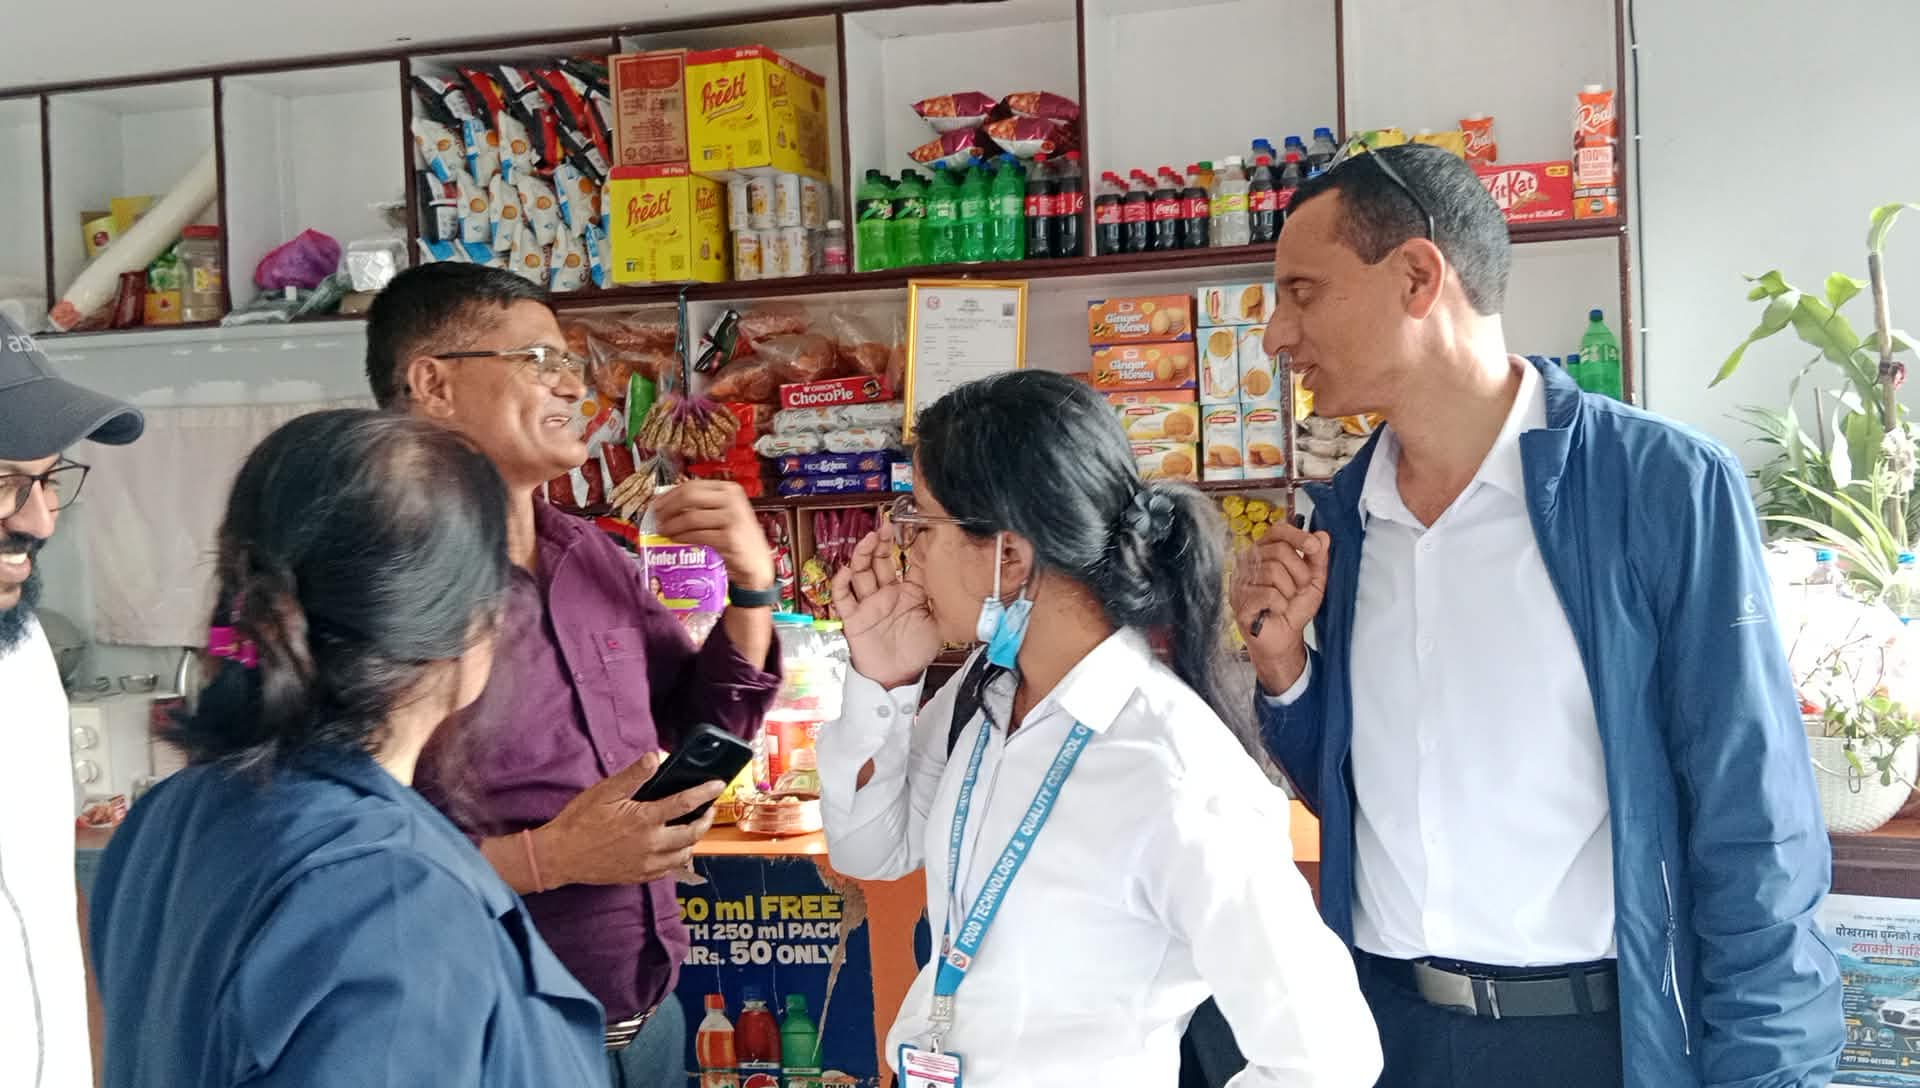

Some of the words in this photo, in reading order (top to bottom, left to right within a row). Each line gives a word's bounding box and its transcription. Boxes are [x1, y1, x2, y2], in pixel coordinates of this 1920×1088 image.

[1114, 322, 1150, 335] Honey
[1110, 360, 1147, 372] Ginger
[1119, 369, 1154, 381] Honey
[789, 387, 854, 406] ChocoPie
[679, 548, 706, 565] fruit
[960, 920, 983, 948] FOOD
[975, 850, 1019, 926] TECHNOLOGY
[1013, 840, 1026, 850] &
[1020, 789, 1053, 837] QUALITY
[1047, 736, 1082, 788] CONTROL
[715, 895, 755, 920] ml
[760, 895, 842, 920] FREE
[712, 924, 753, 940] 250
[757, 923, 784, 939] ml
[788, 922, 842, 939] PACK
[730, 941, 773, 965] 50
